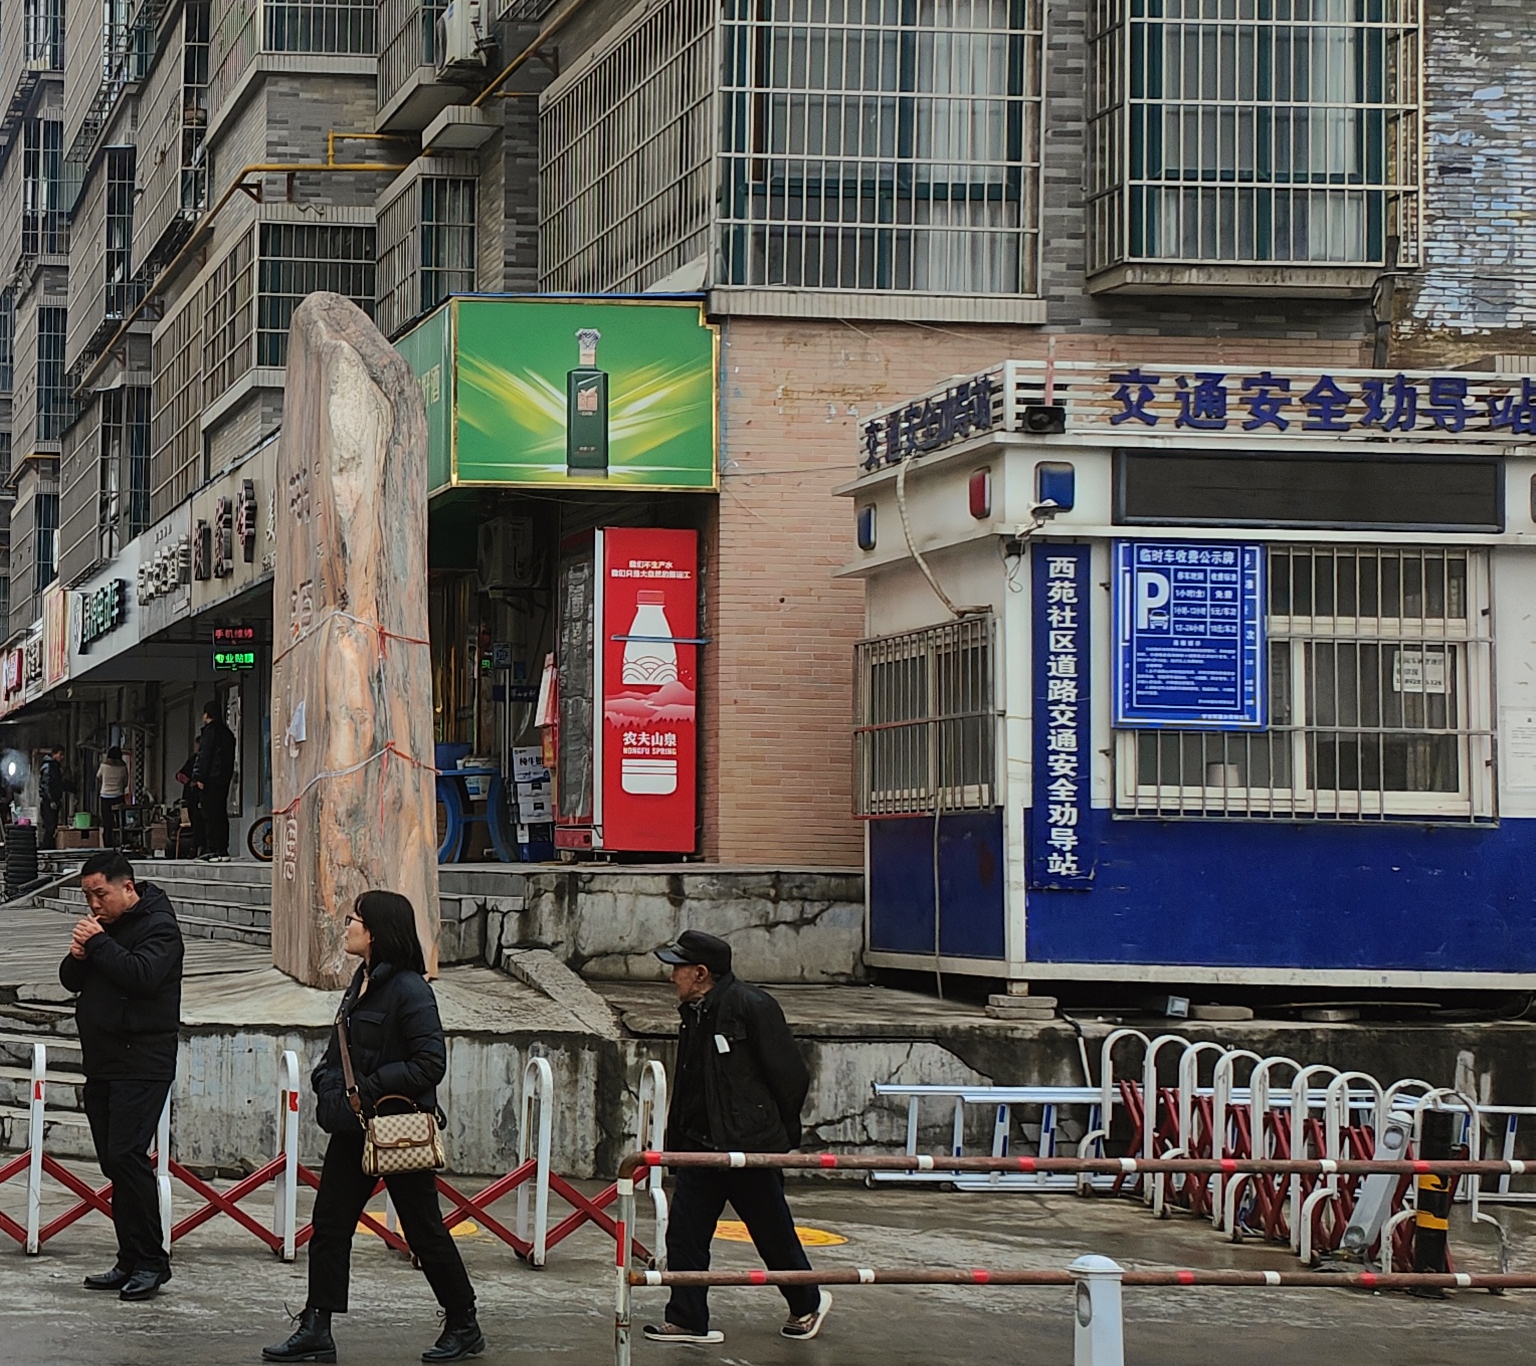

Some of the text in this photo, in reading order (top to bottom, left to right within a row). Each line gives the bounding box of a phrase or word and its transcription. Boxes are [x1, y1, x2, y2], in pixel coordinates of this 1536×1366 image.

[1109, 368, 1536, 434] 交通安全劝导站
[1139, 549, 1235, 564] 临时车收费公示牌
[1046, 556, 1079, 876] 西苑社区道路交通安全劝导站
[622, 732, 677, 747] 农夫山泉
